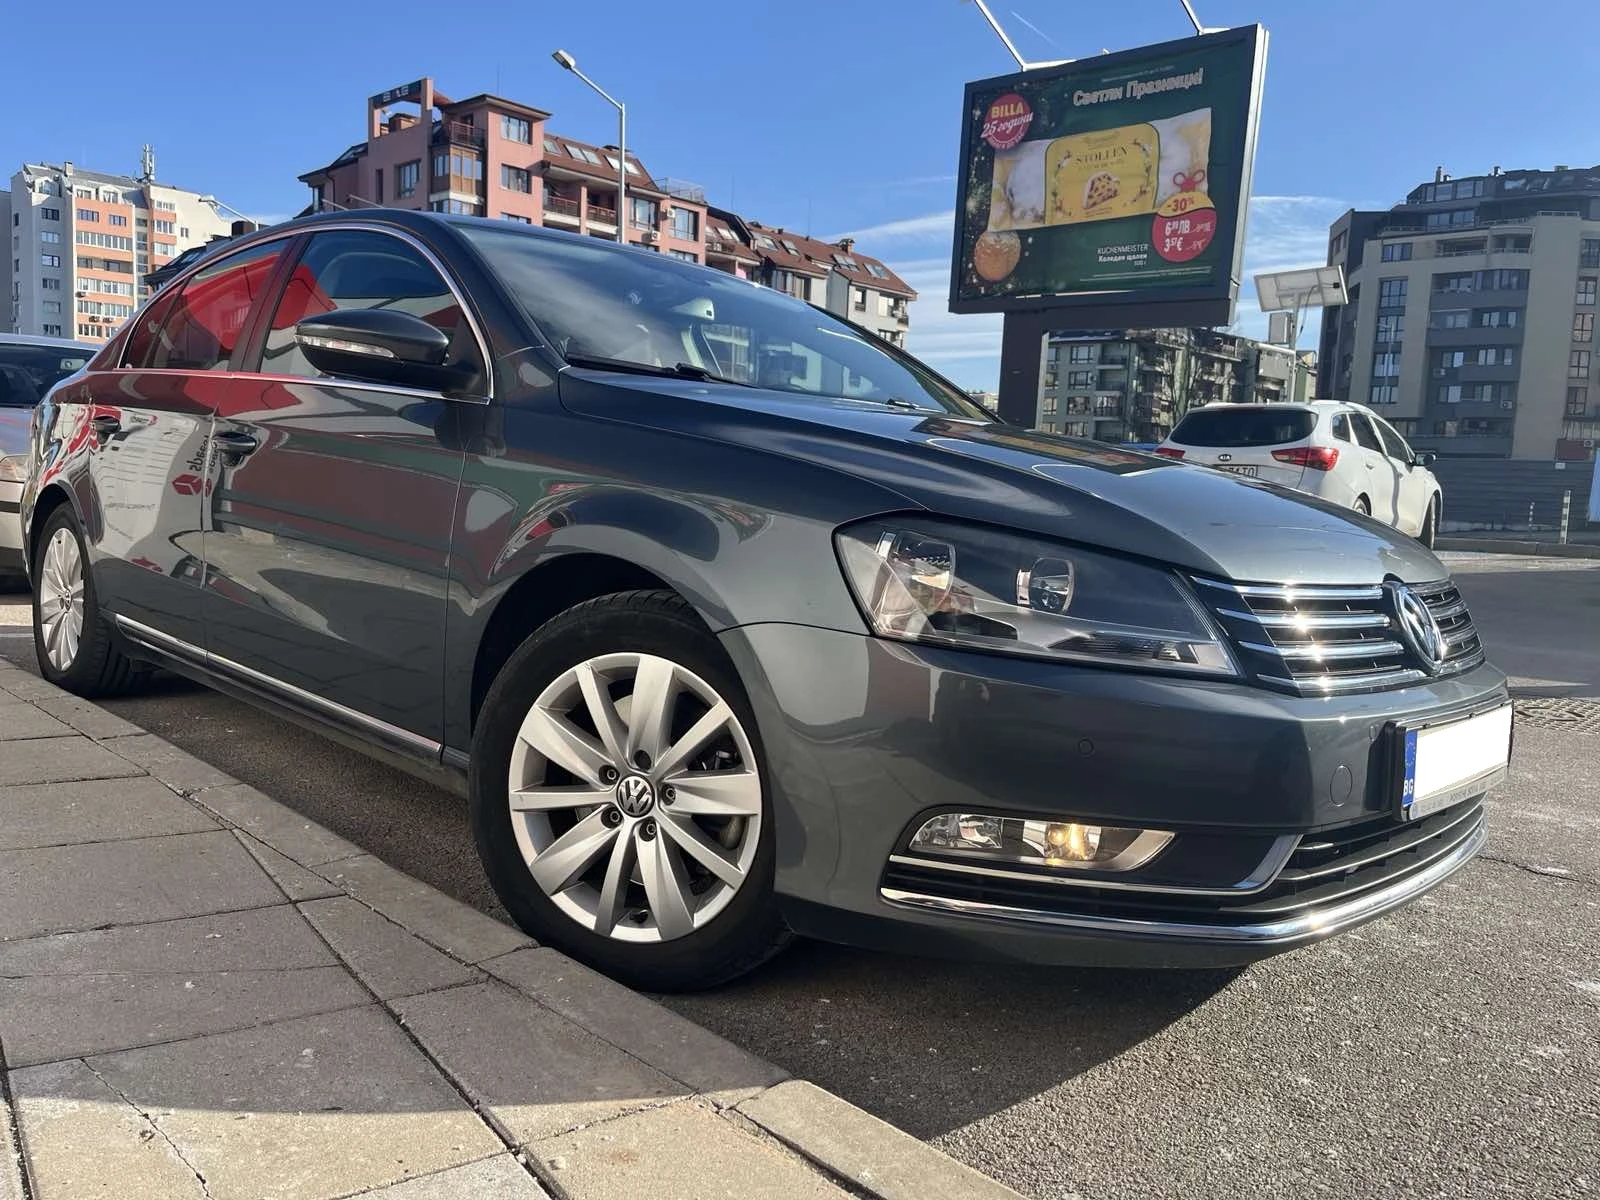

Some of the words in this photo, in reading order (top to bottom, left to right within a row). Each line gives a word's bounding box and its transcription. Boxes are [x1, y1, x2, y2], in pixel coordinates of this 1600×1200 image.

[1073, 87, 1123, 106] Светли
[1126, 67, 1203, 100] Празници!
[991, 103, 1024, 118] BILLA
[980, 120, 998, 138] 25
[1403, 779, 1414, 796] BG
